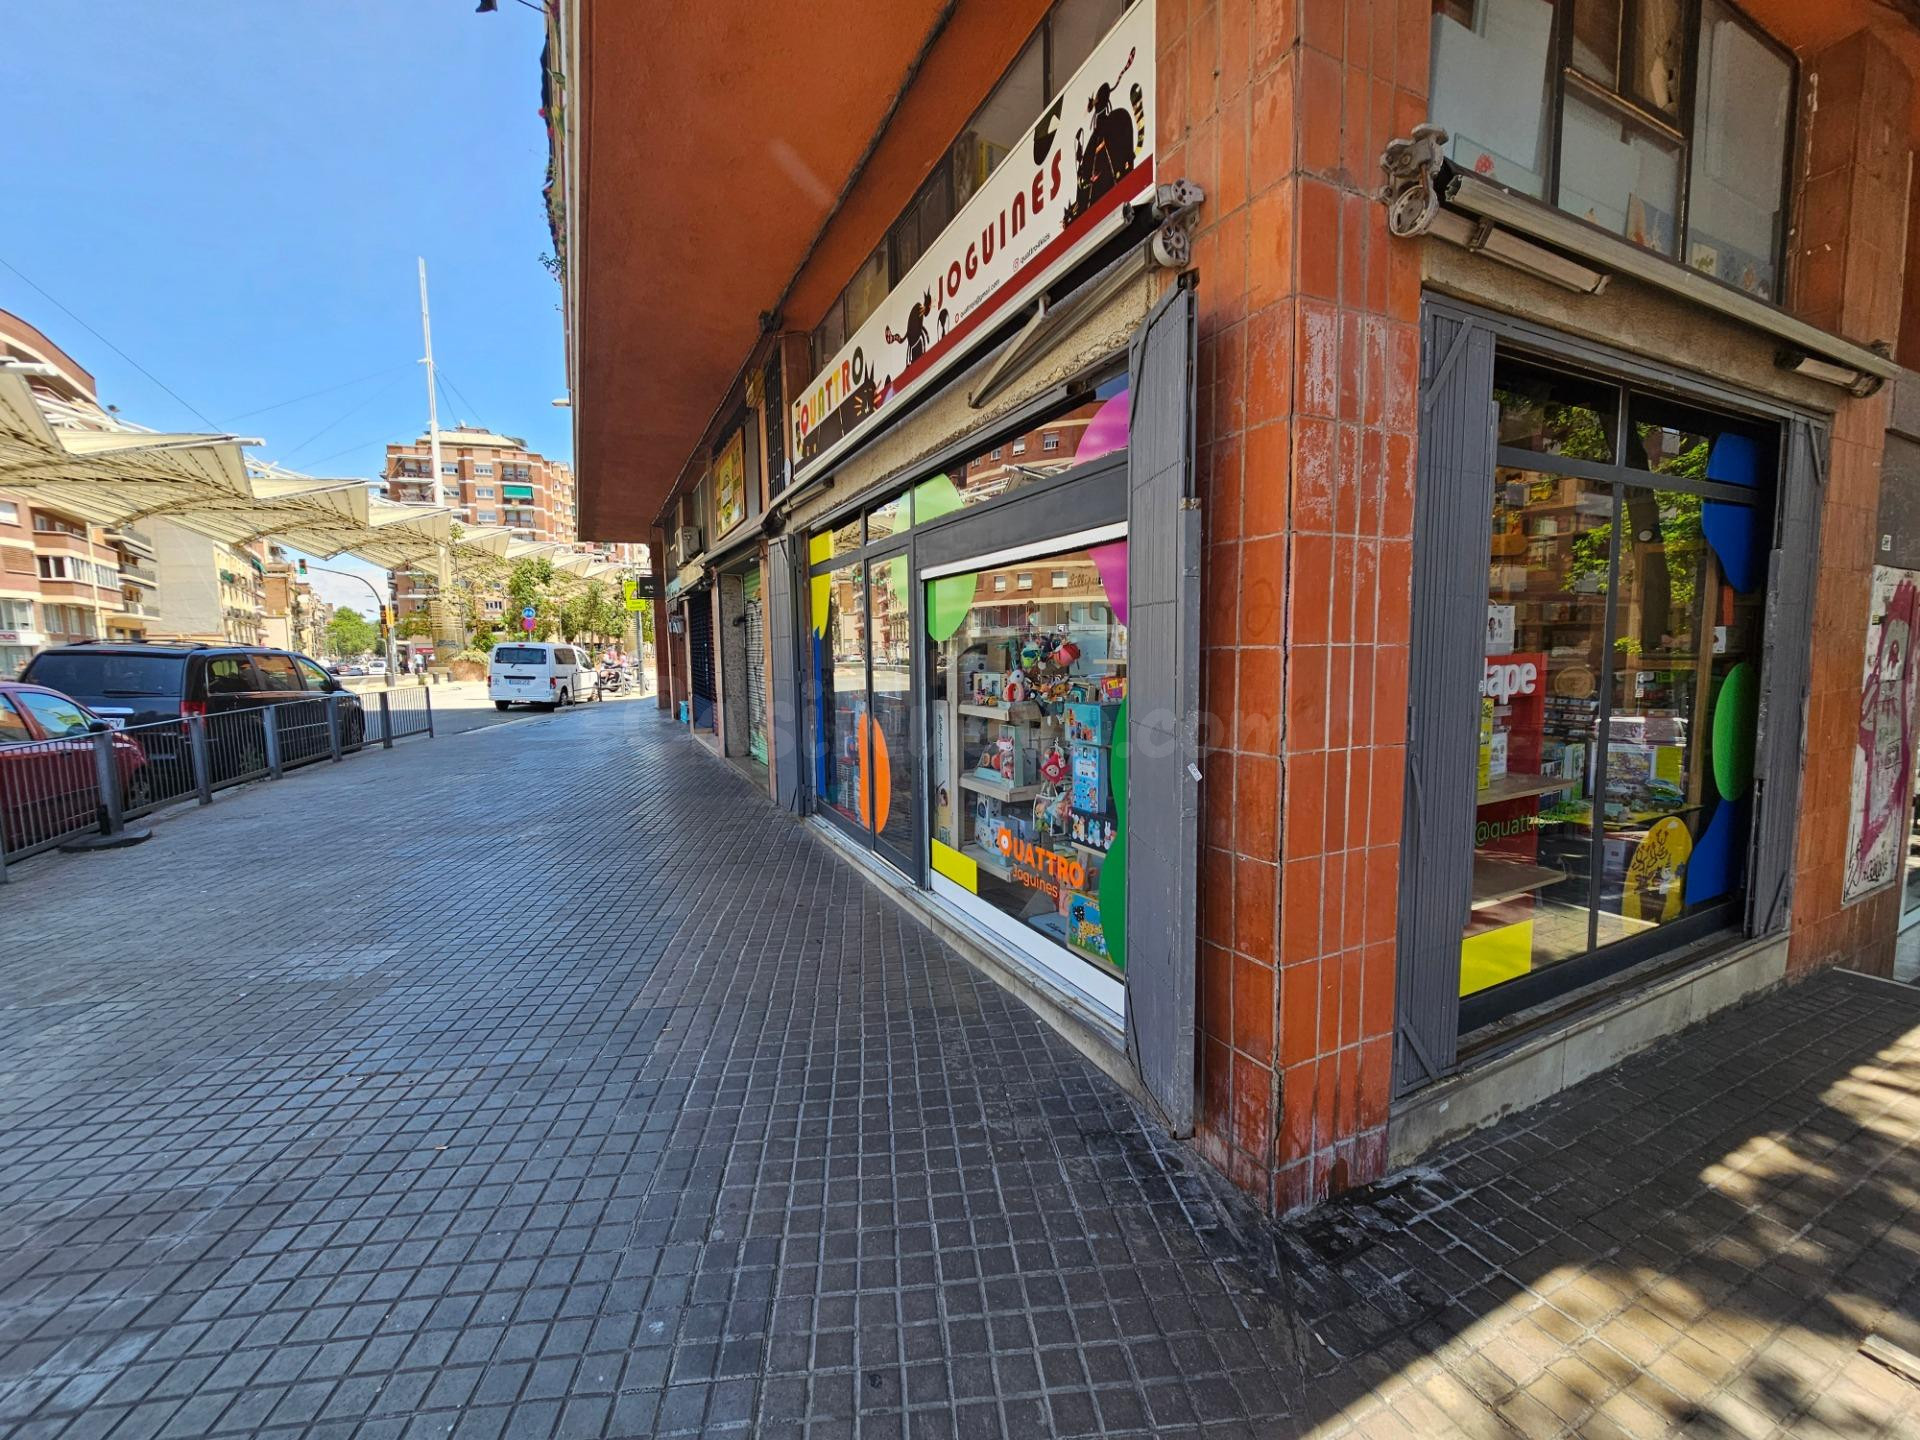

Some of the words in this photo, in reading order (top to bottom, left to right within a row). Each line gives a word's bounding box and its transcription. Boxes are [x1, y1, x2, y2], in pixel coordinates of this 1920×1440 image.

[938, 148, 1062, 311] JOGUINES
[801, 346, 864, 436] QUATTRO
[996, 827, 1085, 889] QUATTRO
